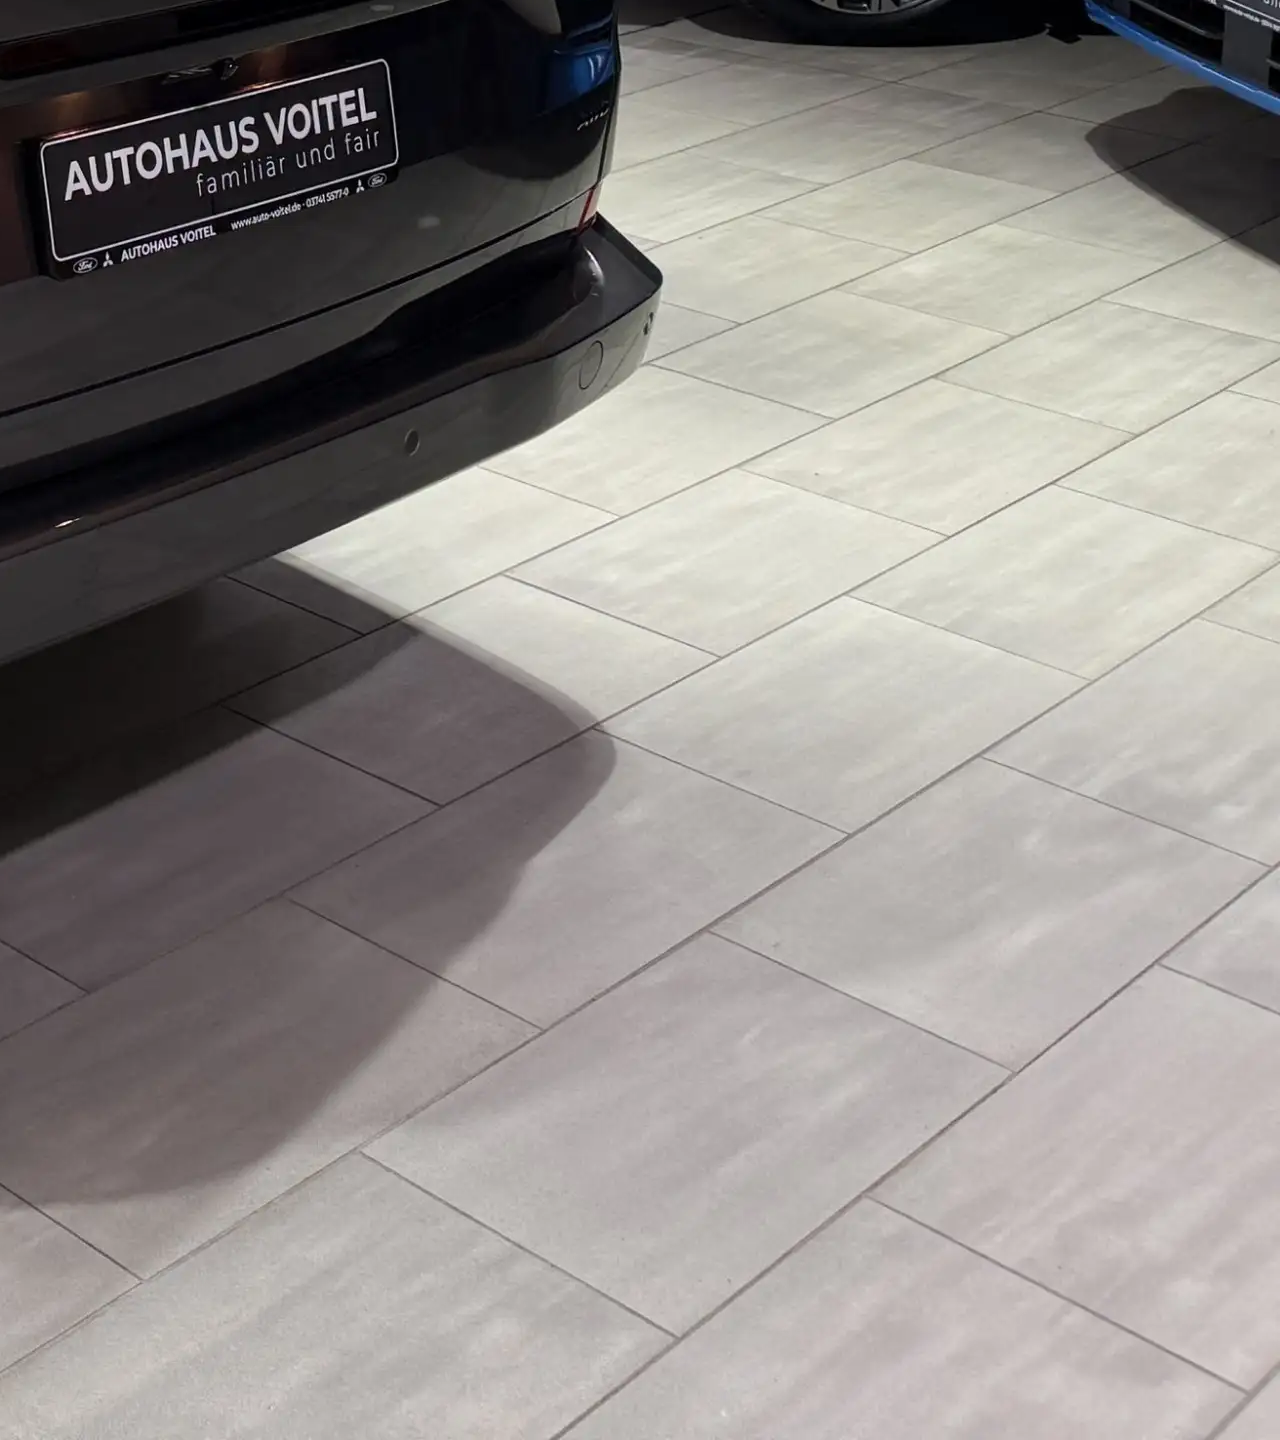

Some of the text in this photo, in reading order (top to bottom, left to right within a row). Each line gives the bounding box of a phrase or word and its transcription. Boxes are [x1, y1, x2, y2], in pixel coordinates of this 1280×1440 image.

[63, 87, 378, 202] AUTOHAUS VOITEL
[196, 128, 382, 198] familiär und fair
[120, 235, 179, 263] AUTOHAUS
[180, 225, 217, 245] VOITEL
